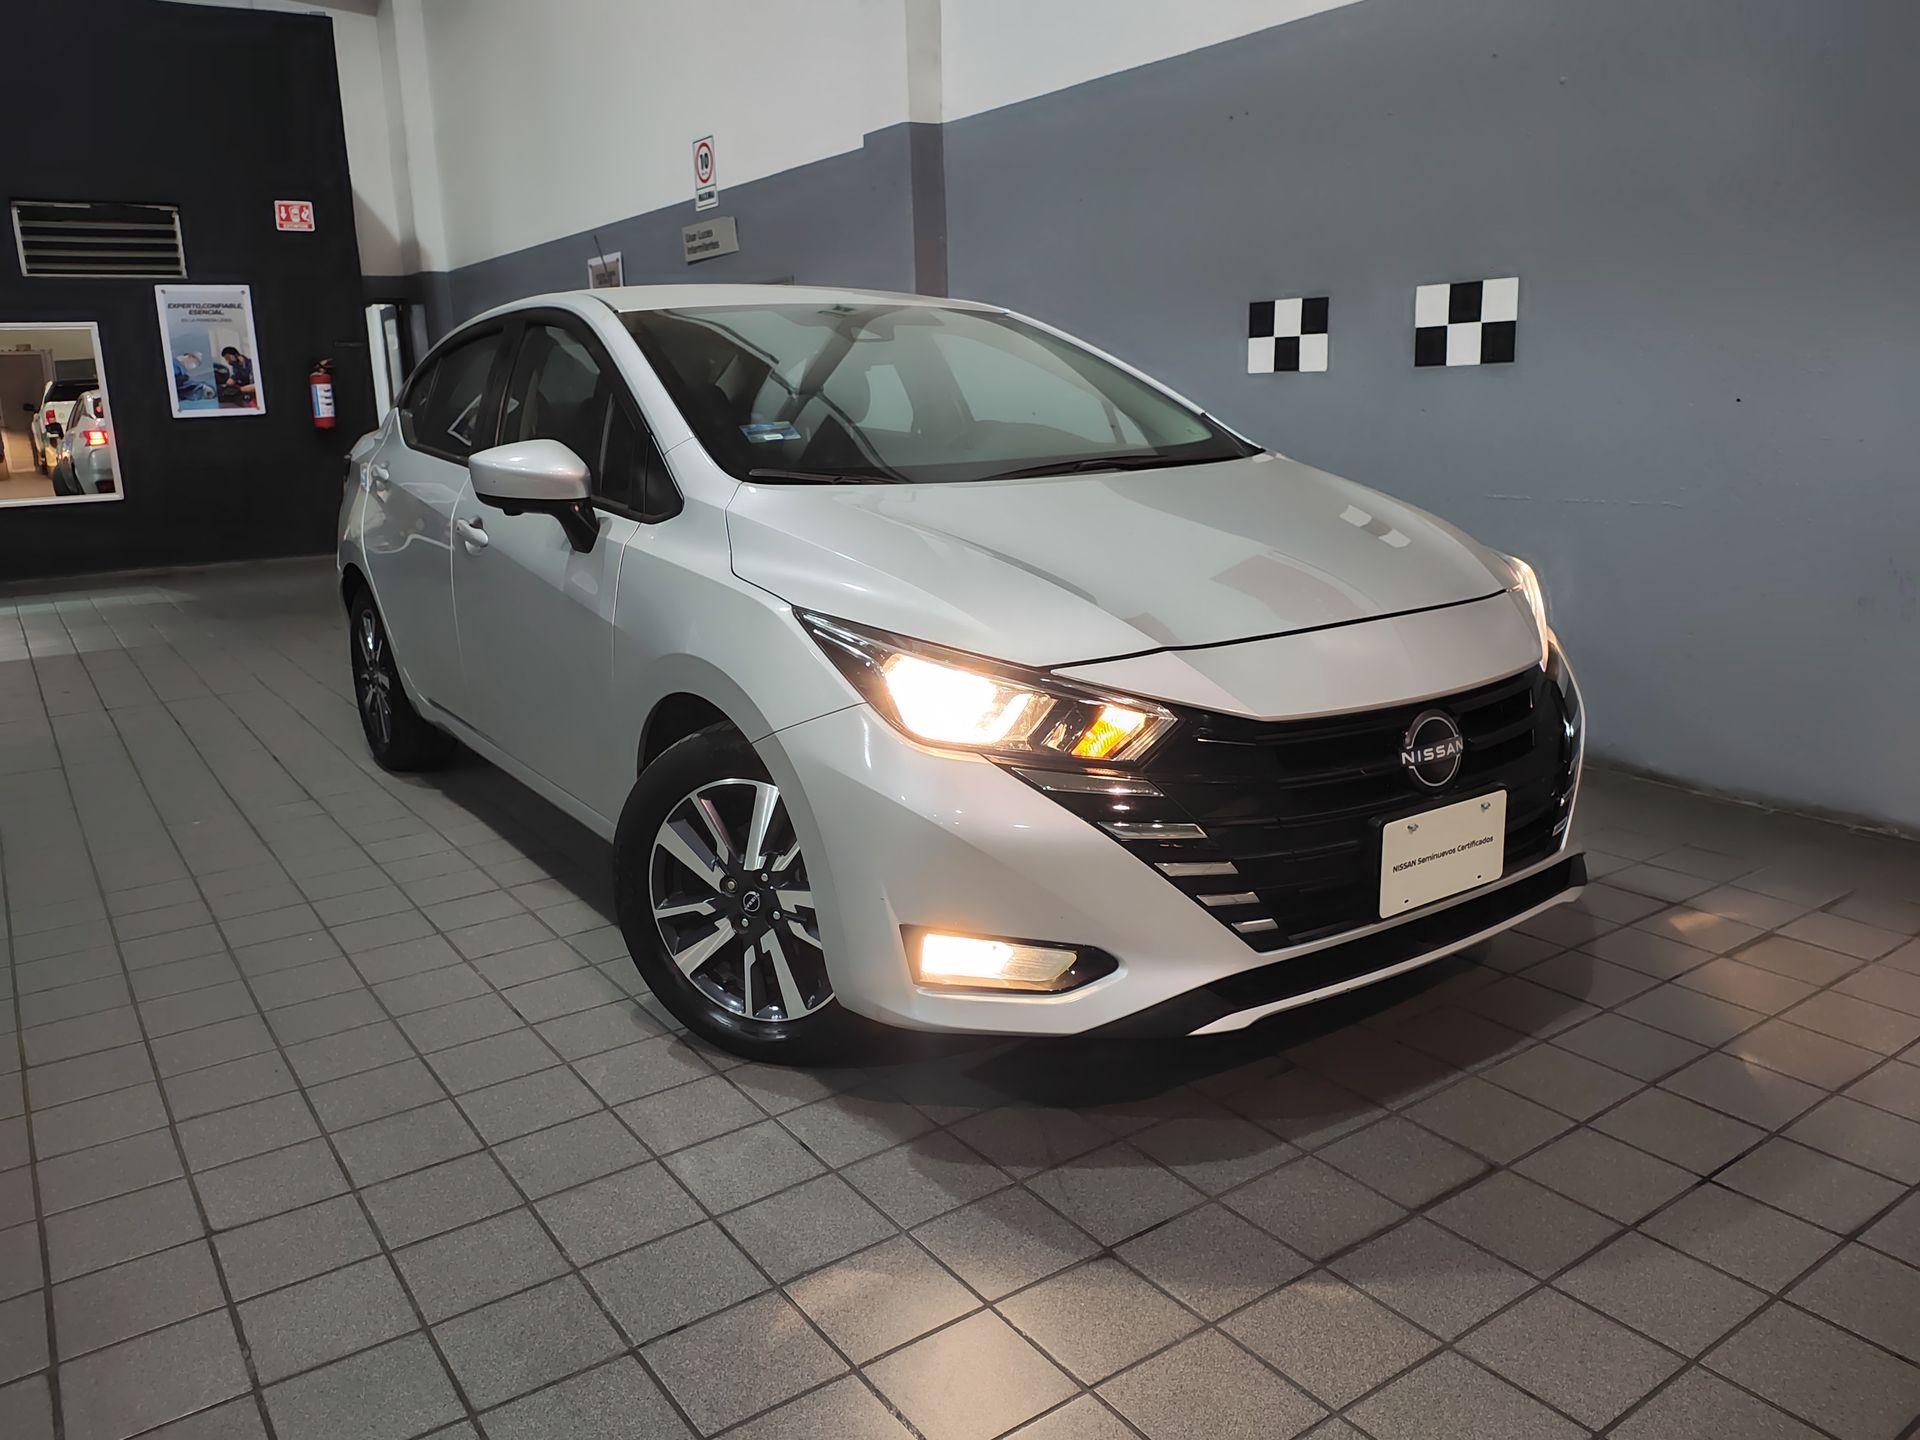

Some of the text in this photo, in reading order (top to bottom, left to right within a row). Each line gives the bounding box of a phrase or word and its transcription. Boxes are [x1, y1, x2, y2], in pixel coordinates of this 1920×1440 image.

[700, 153, 709, 170] 10
[1401, 739, 1464, 765] NISSAN
[1392, 835, 1495, 874] NISSAN Seminuevos Certificados
